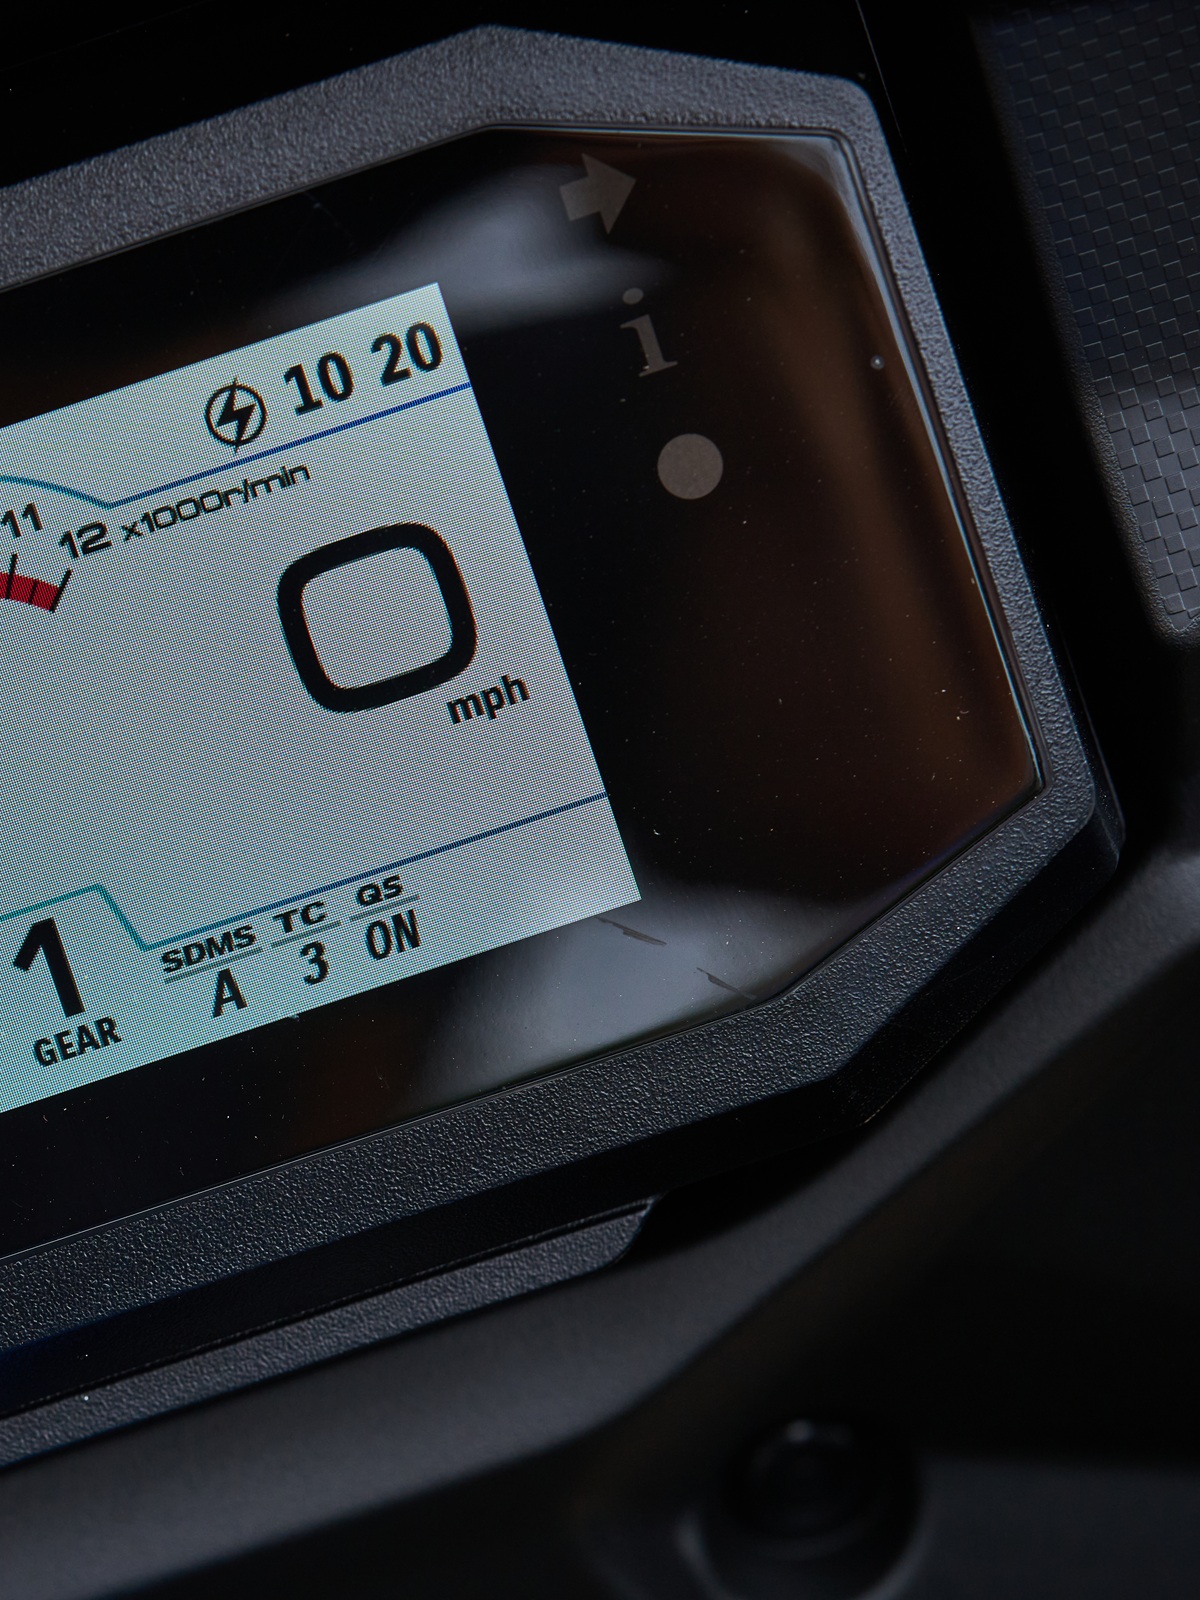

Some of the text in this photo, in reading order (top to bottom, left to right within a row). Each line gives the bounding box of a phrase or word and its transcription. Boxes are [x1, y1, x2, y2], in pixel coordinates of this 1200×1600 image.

[283, 322, 443, 415] 10 20
[1, 502, 44, 537] 11
[59, 522, 113, 558] 12
[277, 522, 477, 715] 0
[446, 675, 530, 724] mph
[13, 917, 85, 1018] 1
[161, 875, 403, 973] SDMS TC QS
[210, 908, 421, 1018] A 3 ON
[33, 1017, 122, 1067] GEAR
